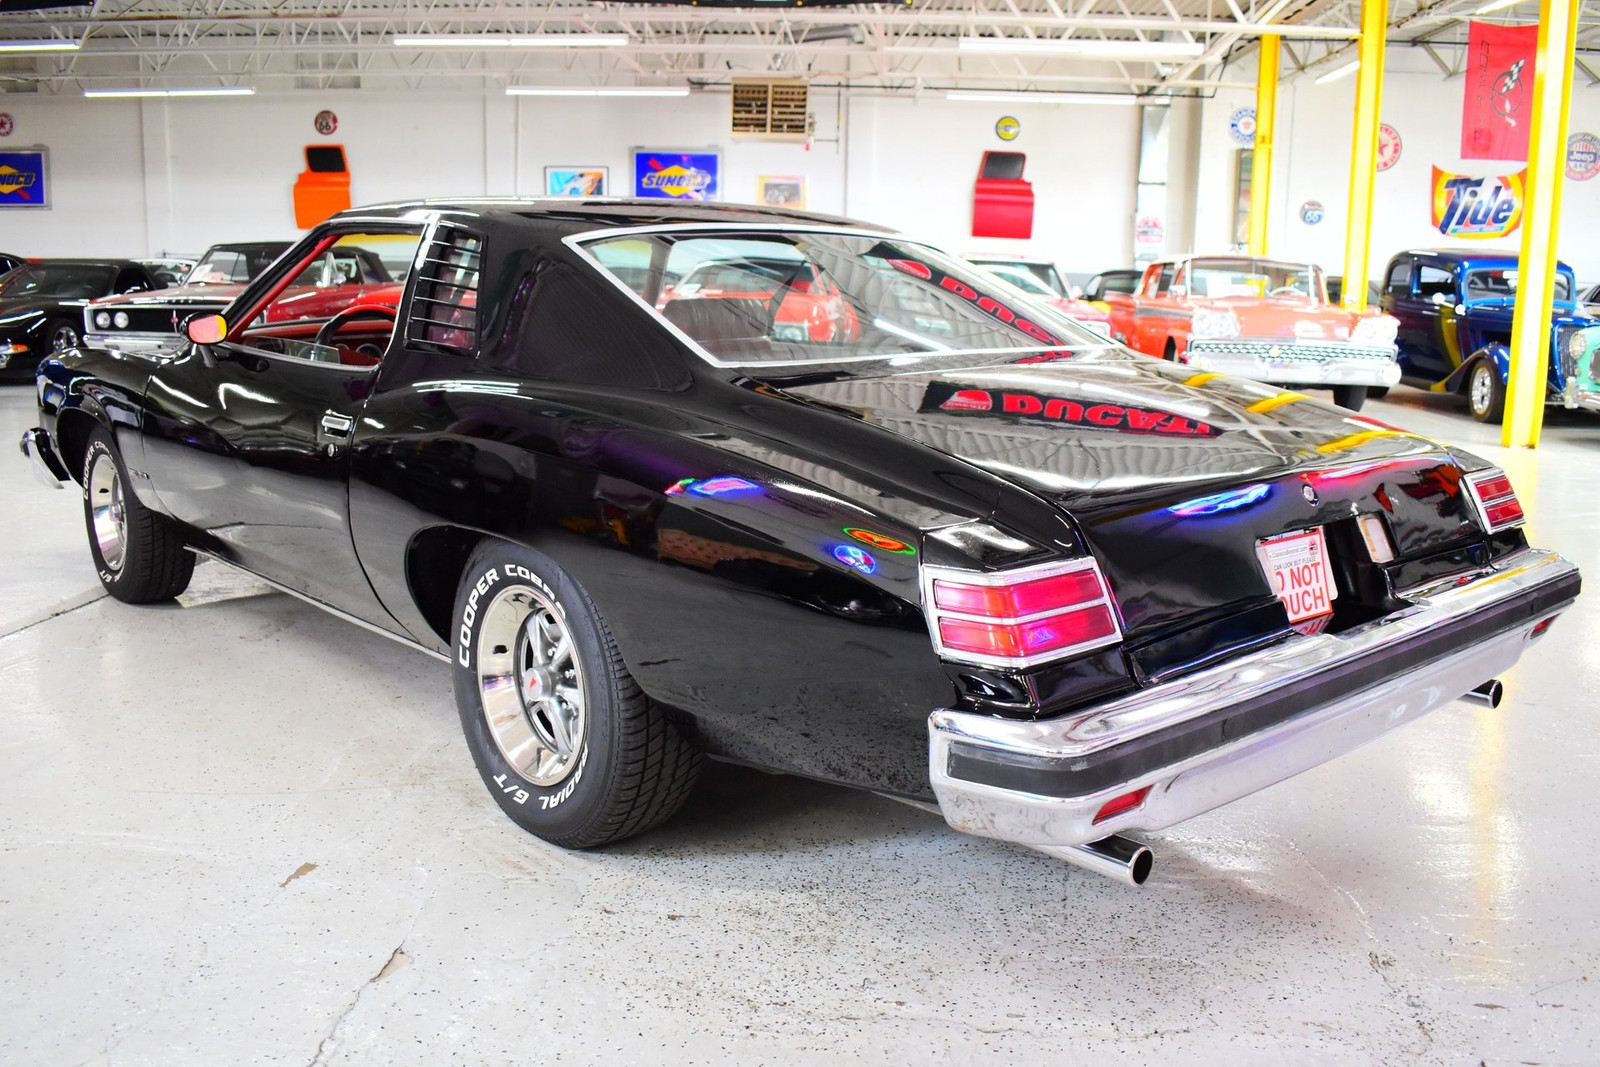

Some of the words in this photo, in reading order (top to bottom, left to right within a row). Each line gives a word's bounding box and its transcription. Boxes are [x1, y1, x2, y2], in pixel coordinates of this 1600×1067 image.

[319, 121, 331, 131] 66
[1569, 151, 1595, 164] Jeep
[1439, 177, 1516, 235] Tide
[1289, 561, 1321, 590] NOT
[459, 567, 500, 669] COOPER
[492, 773, 530, 805] G/T
